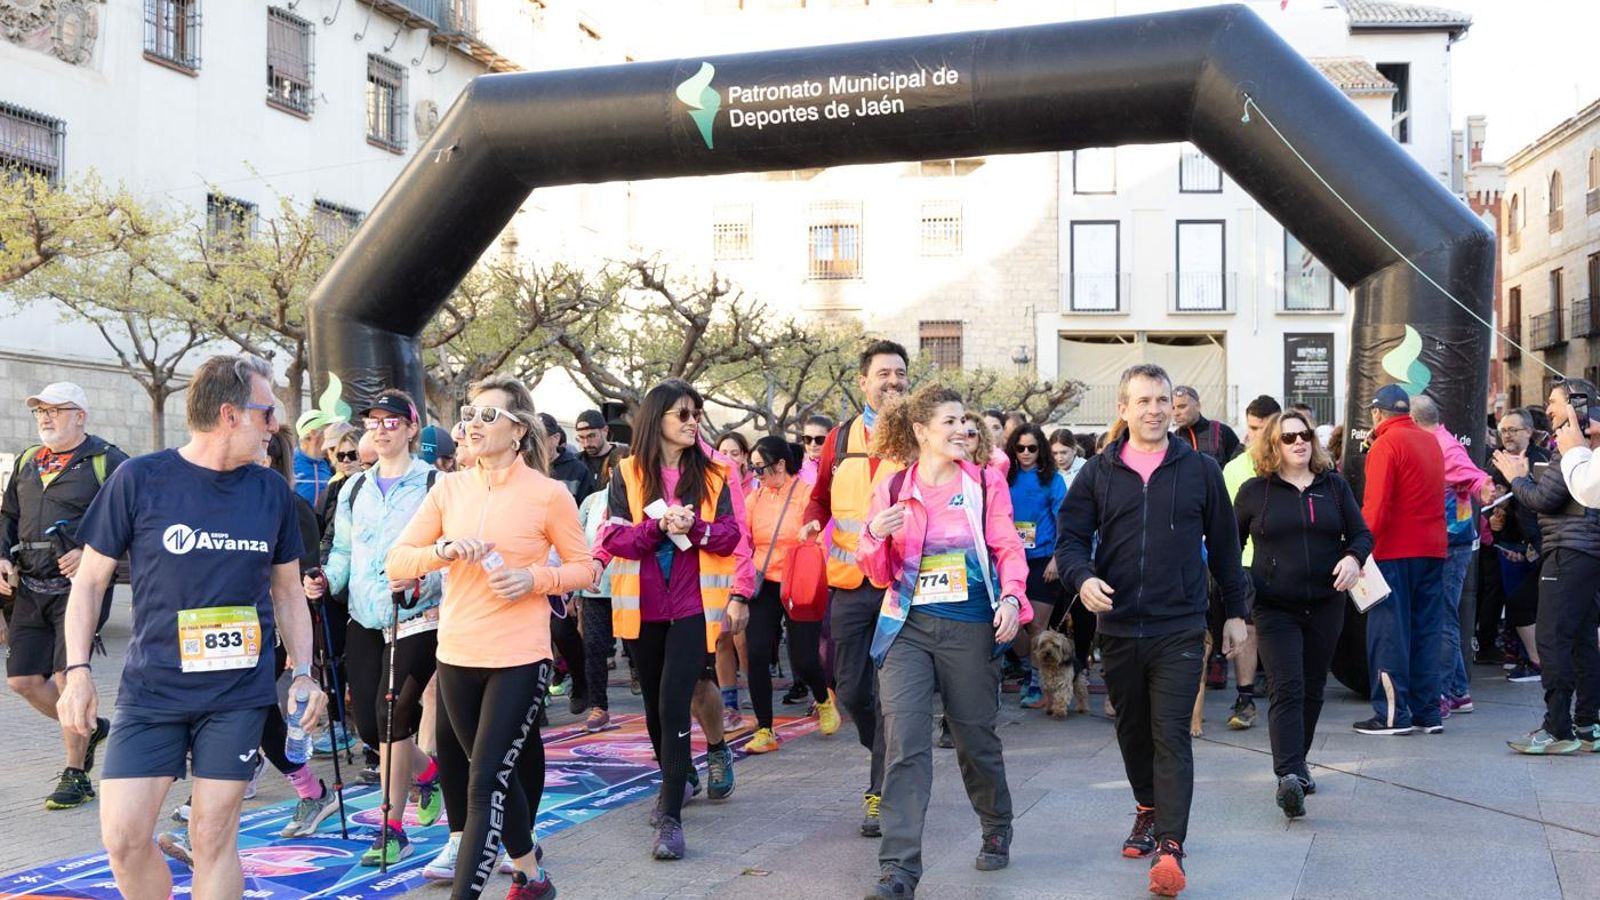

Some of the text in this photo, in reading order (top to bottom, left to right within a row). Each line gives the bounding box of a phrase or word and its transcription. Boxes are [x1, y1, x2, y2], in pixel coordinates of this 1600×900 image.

[728, 67, 959, 104] Patronato Municipal de
[729, 94, 905, 130] Deportes de Jaén
[195, 532, 269, 552] Avanza
[920, 573, 949, 588] 774
[205, 631, 243, 649] 833
[470, 790, 507, 893] UNDER
